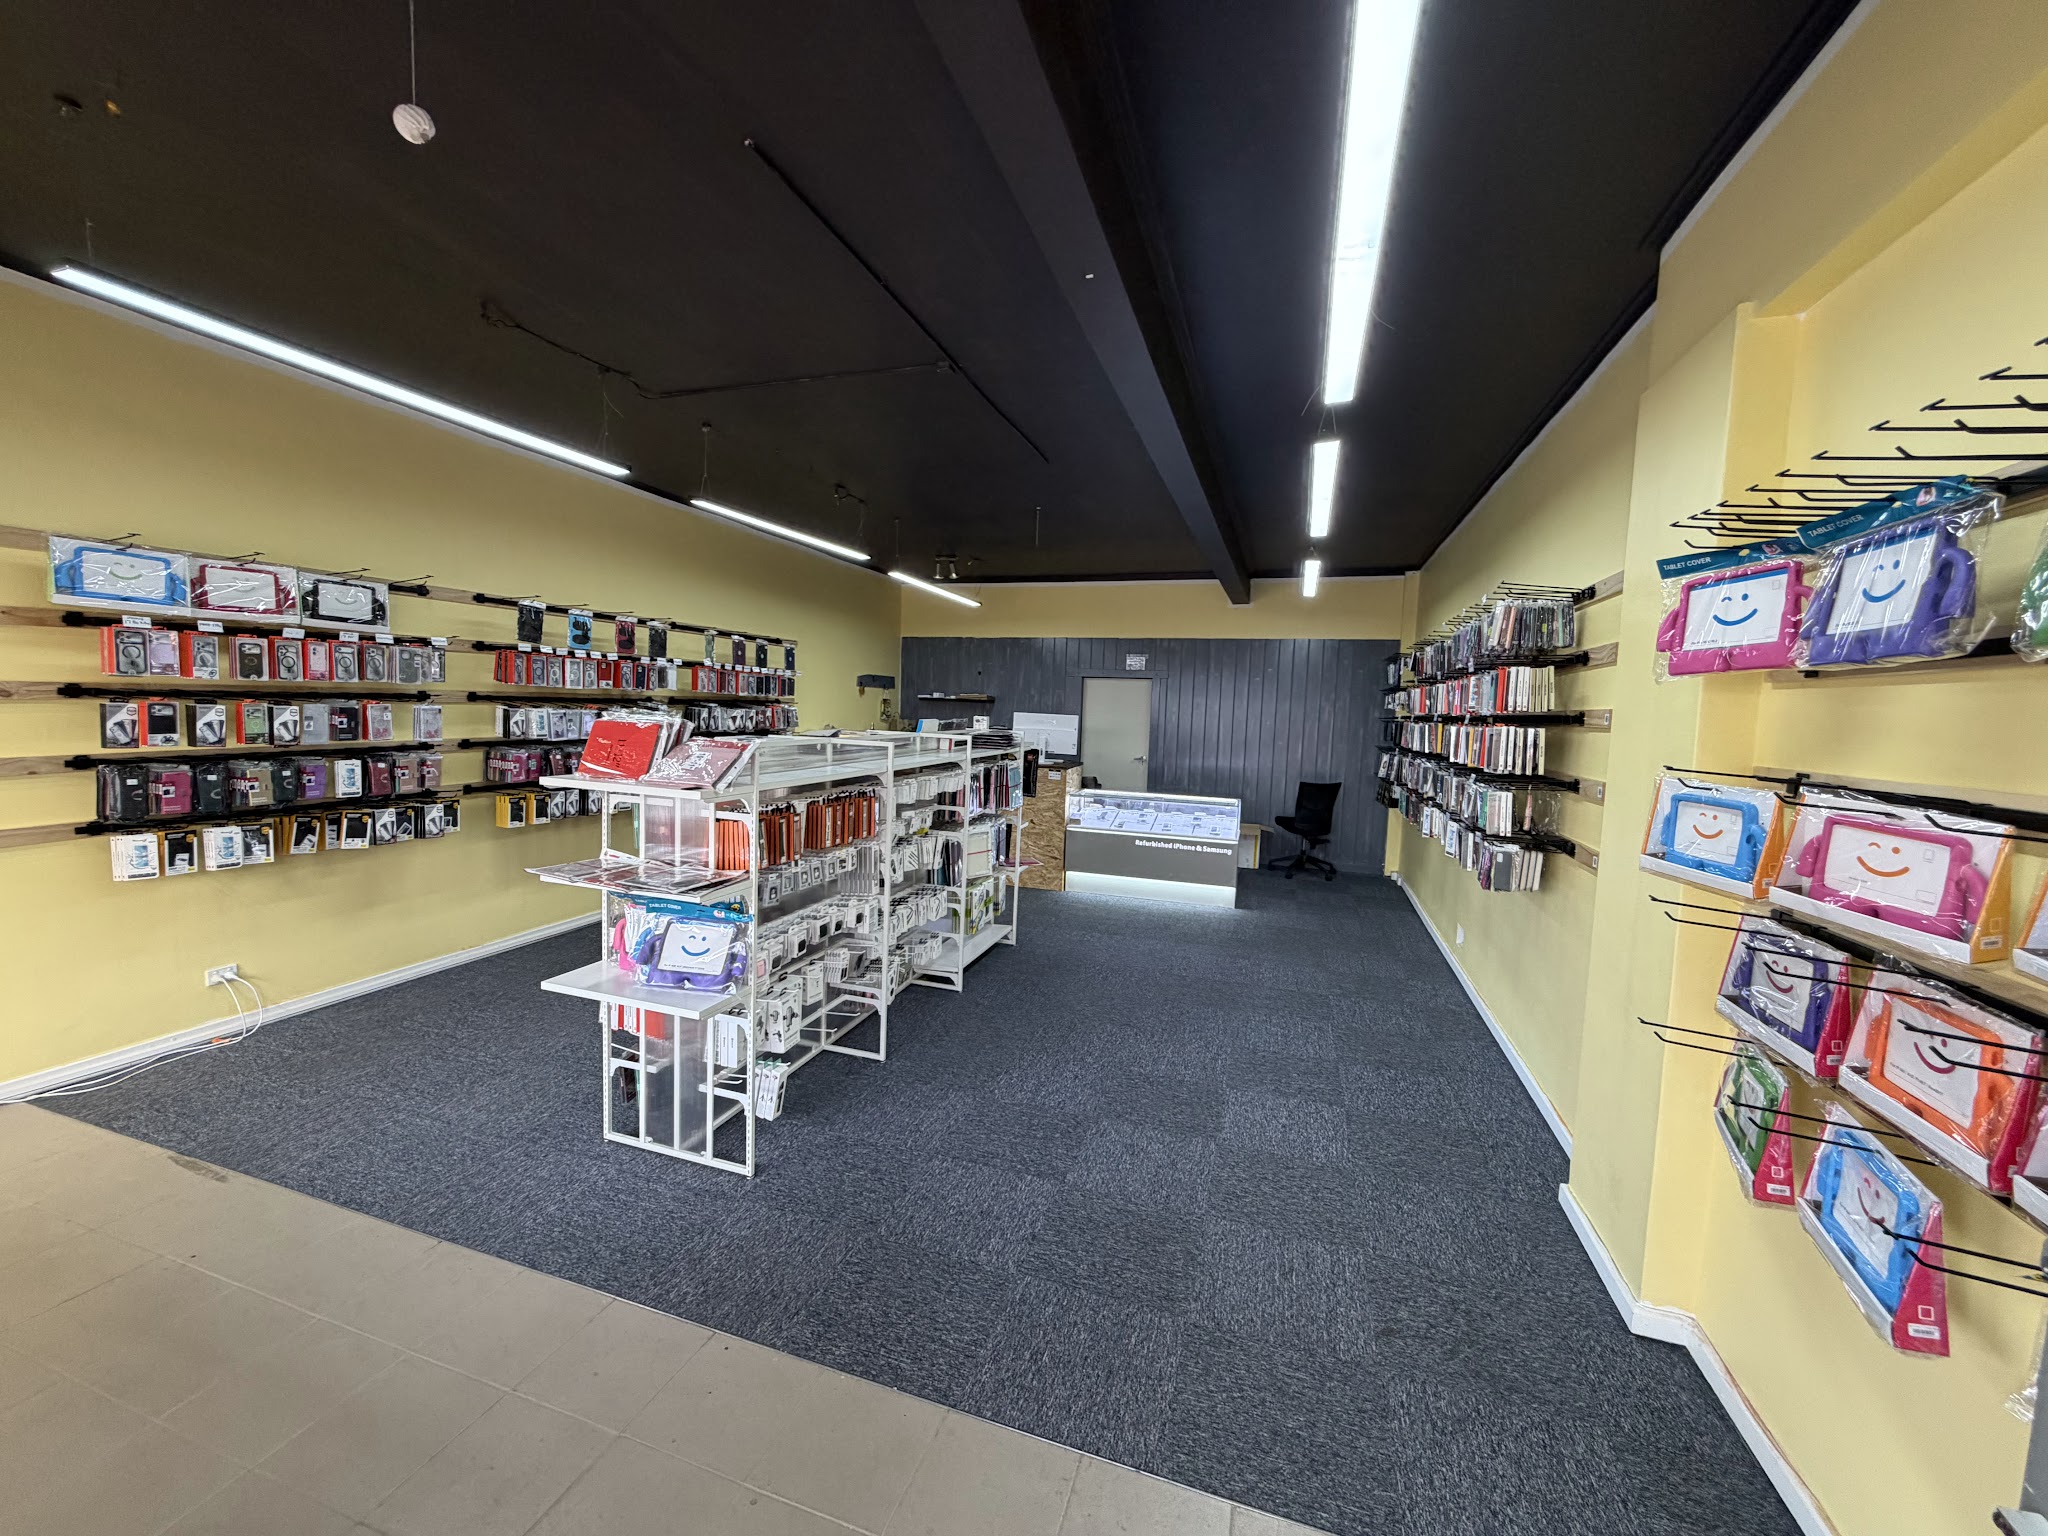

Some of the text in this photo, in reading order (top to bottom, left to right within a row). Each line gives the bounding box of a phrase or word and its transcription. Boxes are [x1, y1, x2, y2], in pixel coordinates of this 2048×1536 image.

[1807, 514, 1864, 537] TABLET COVER
[1663, 556, 1712, 571] TABLET COVER
[1135, 839, 1173, 849] Refurbished
[1173, 843, 1196, 852] iPhone
[1202, 845, 1233, 856] Samsung
